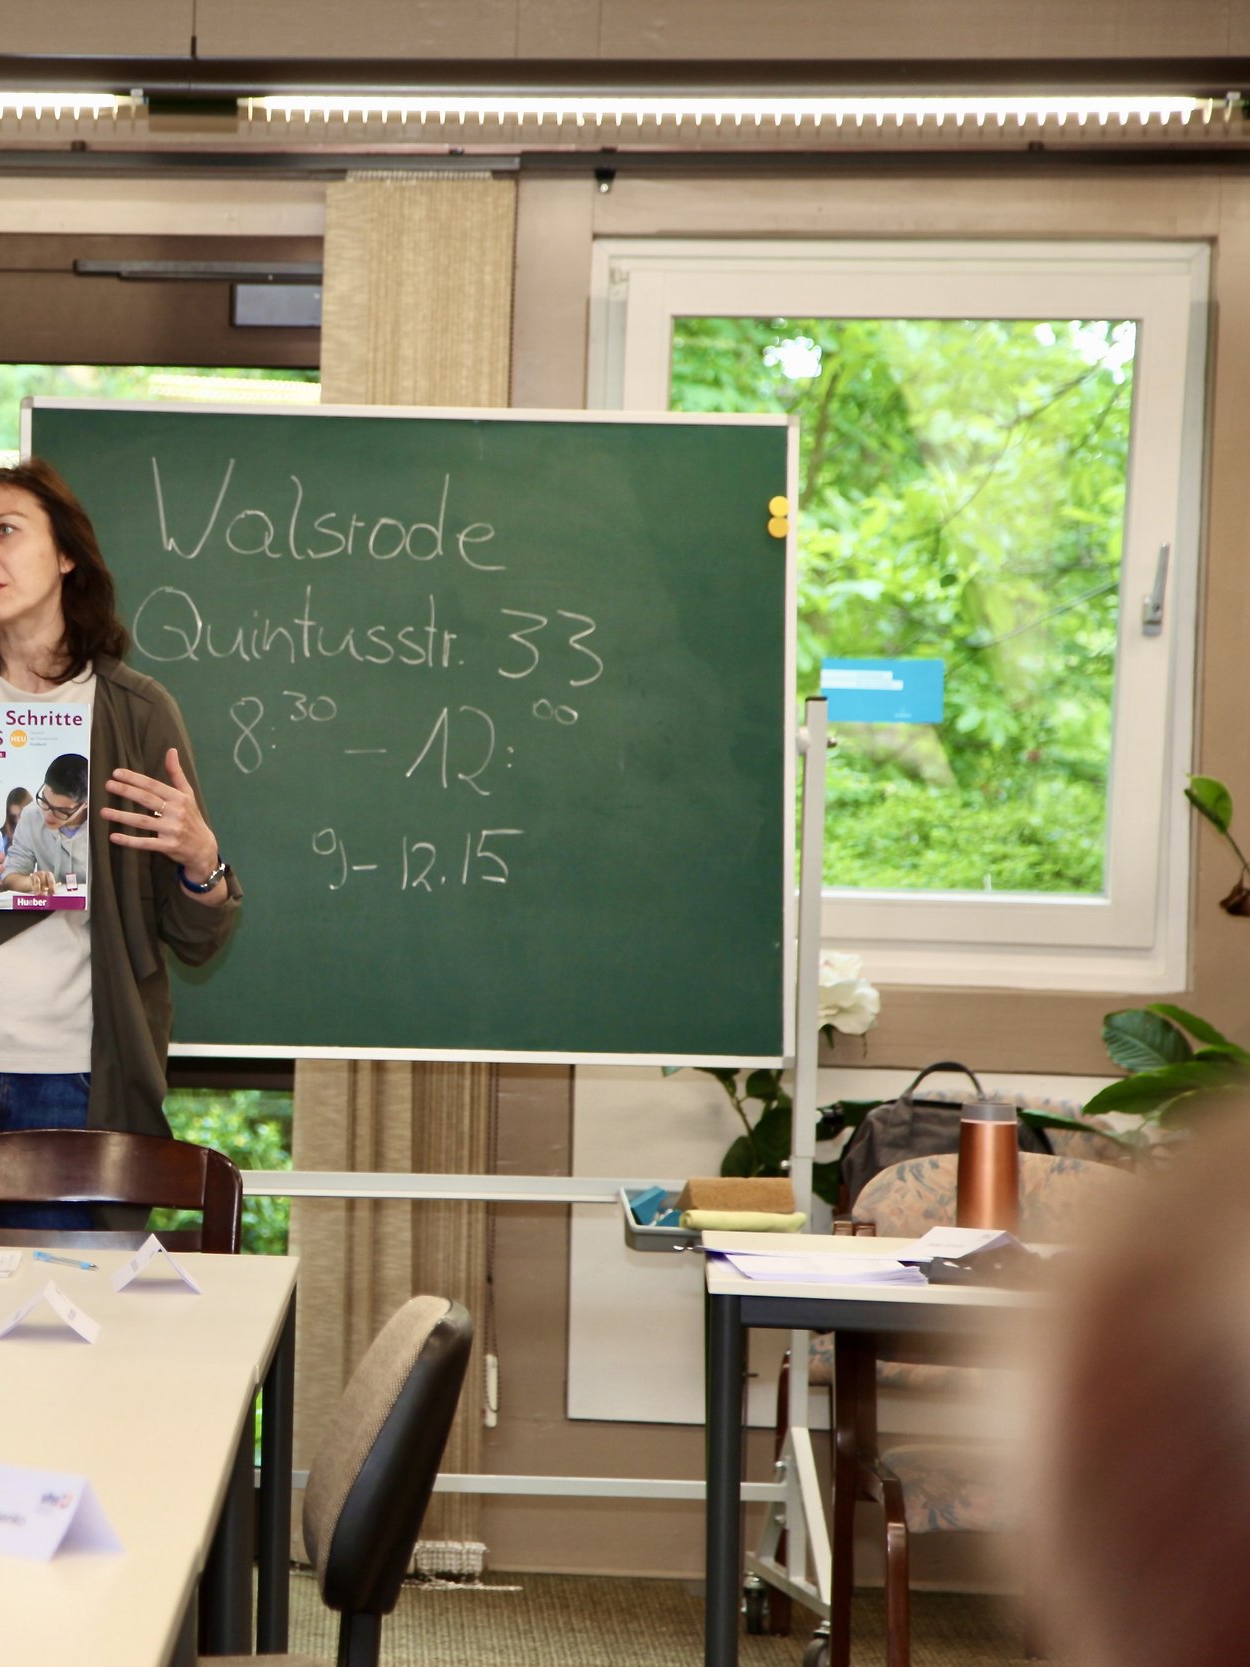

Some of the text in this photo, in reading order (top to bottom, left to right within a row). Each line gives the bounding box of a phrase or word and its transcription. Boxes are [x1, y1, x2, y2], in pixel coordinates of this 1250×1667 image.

[151, 456, 507, 572] Walsrode
[132, 584, 605, 687] Quintusstr. 33
[4, 709, 84, 727] Schritte
[10, 735, 28, 743] NEU
[16, 897, 47, 907] Hueber
